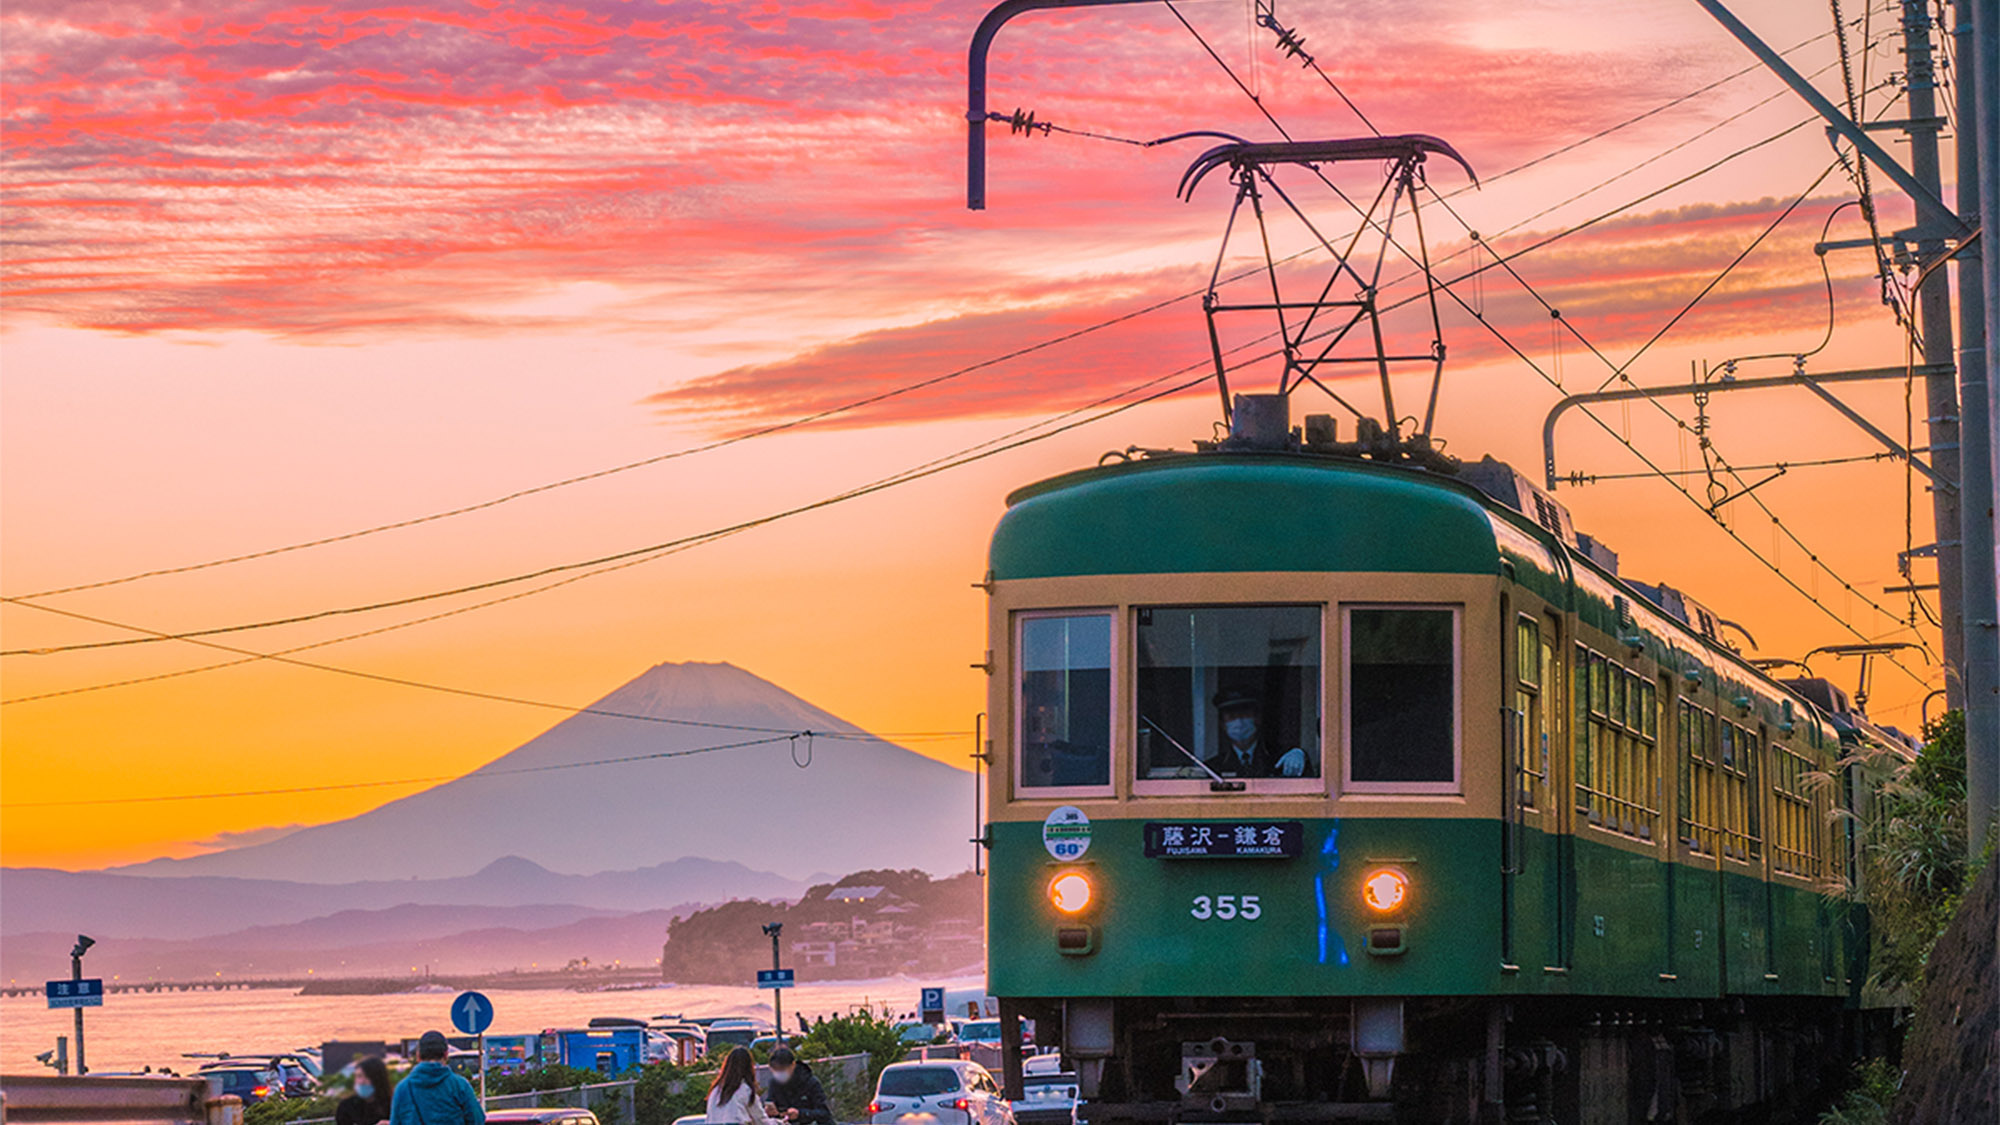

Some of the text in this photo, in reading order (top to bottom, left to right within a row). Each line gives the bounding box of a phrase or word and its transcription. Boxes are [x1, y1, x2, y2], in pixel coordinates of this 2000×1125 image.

[1166, 847, 1283, 855] FUJISAWA KAMAKURA
[1191, 895, 1261, 920] 355
[925, 990, 939, 1007] P
